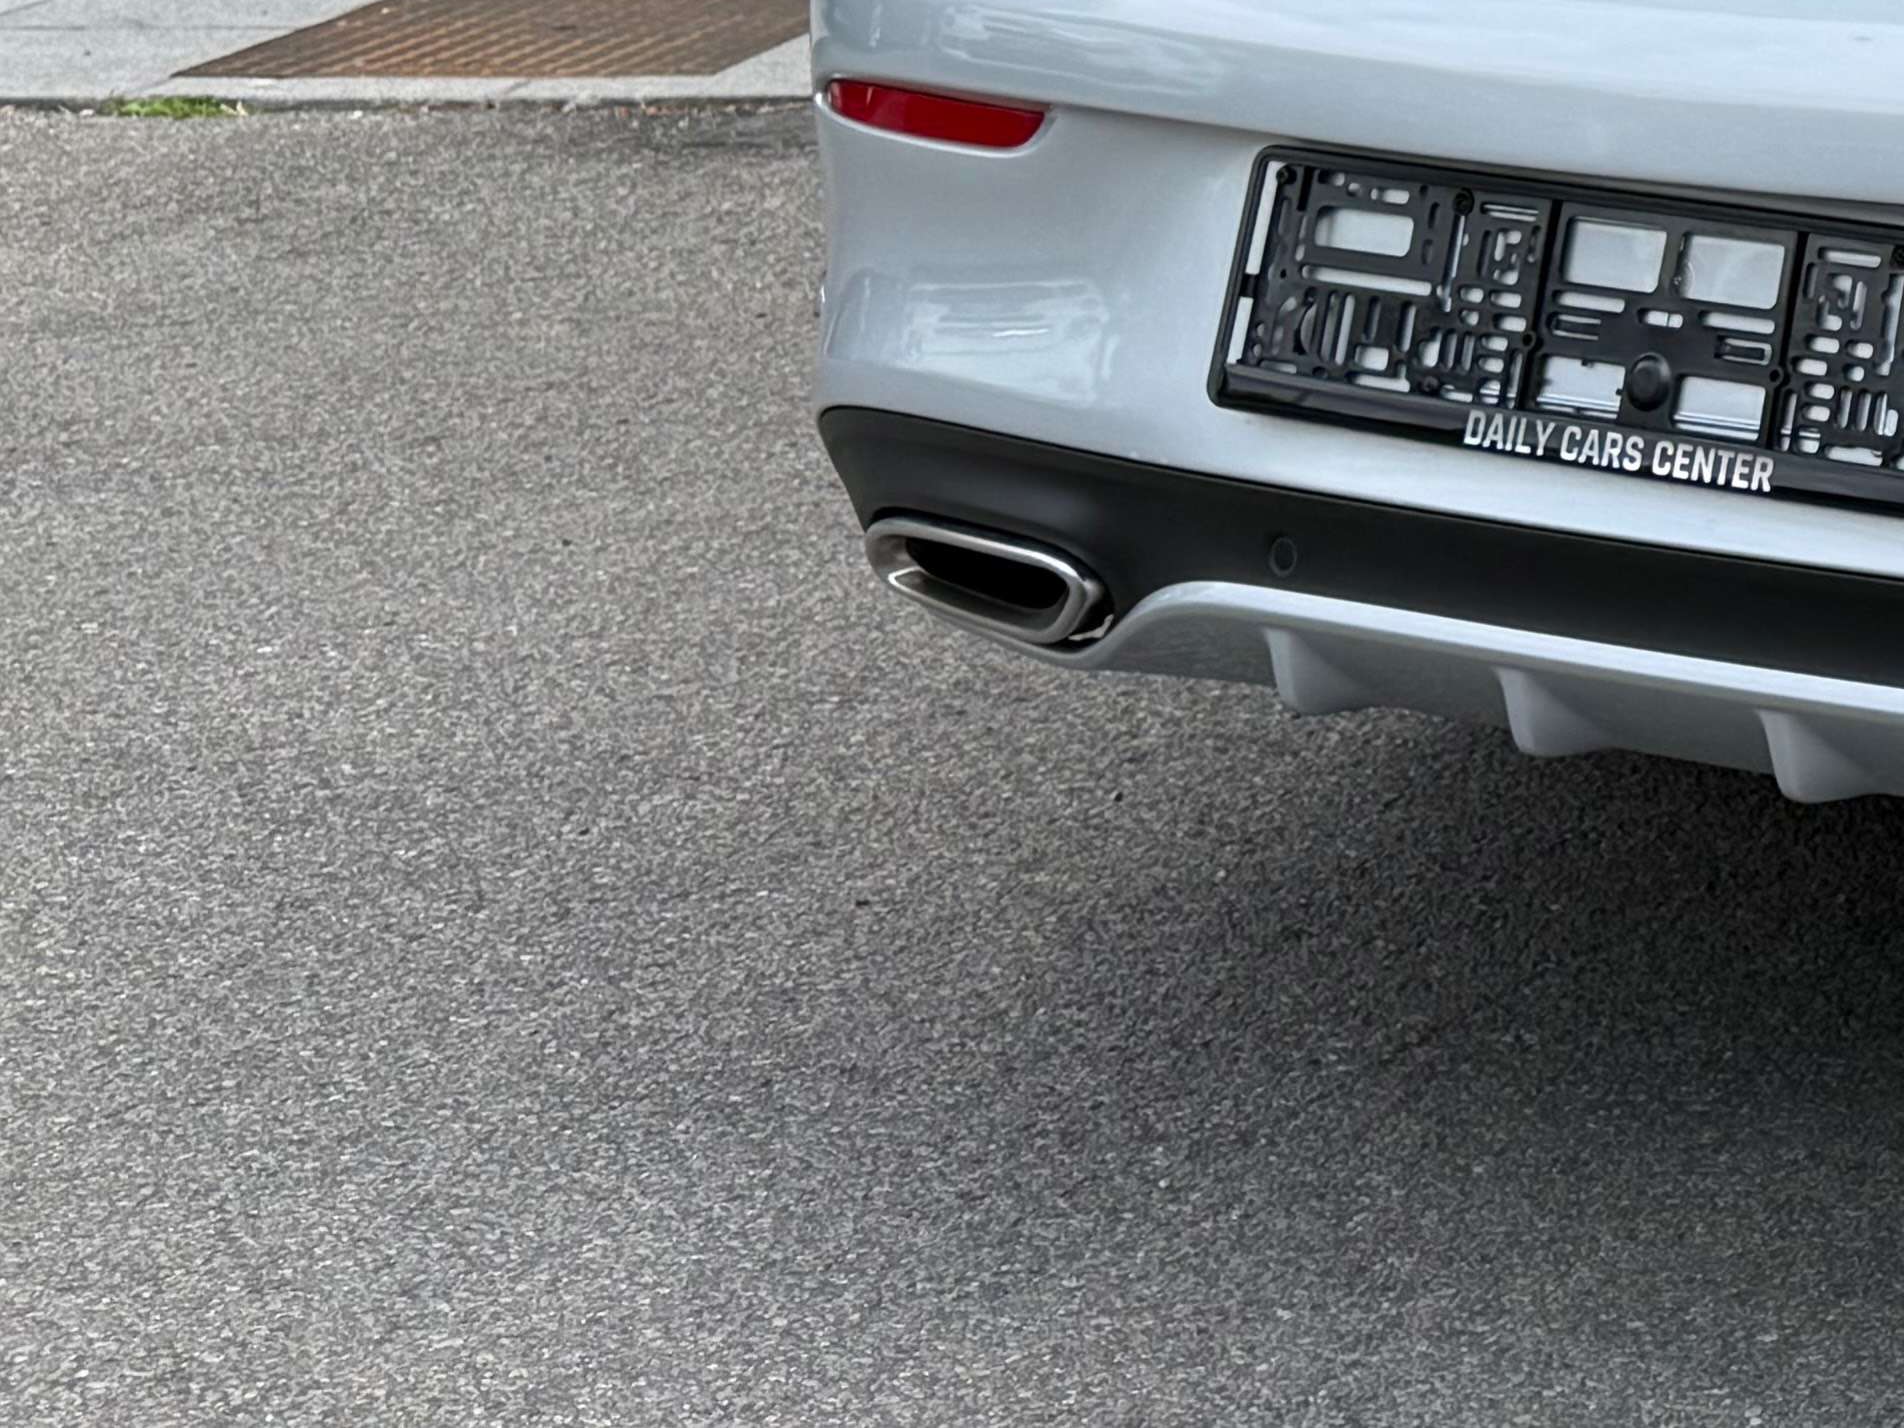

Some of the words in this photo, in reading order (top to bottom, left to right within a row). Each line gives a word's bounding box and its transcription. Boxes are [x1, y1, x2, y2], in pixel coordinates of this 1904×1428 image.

[1463, 409, 1556, 457] DAILY
[1559, 425, 1645, 472] CARS
[1651, 440, 1776, 493] CENTER
